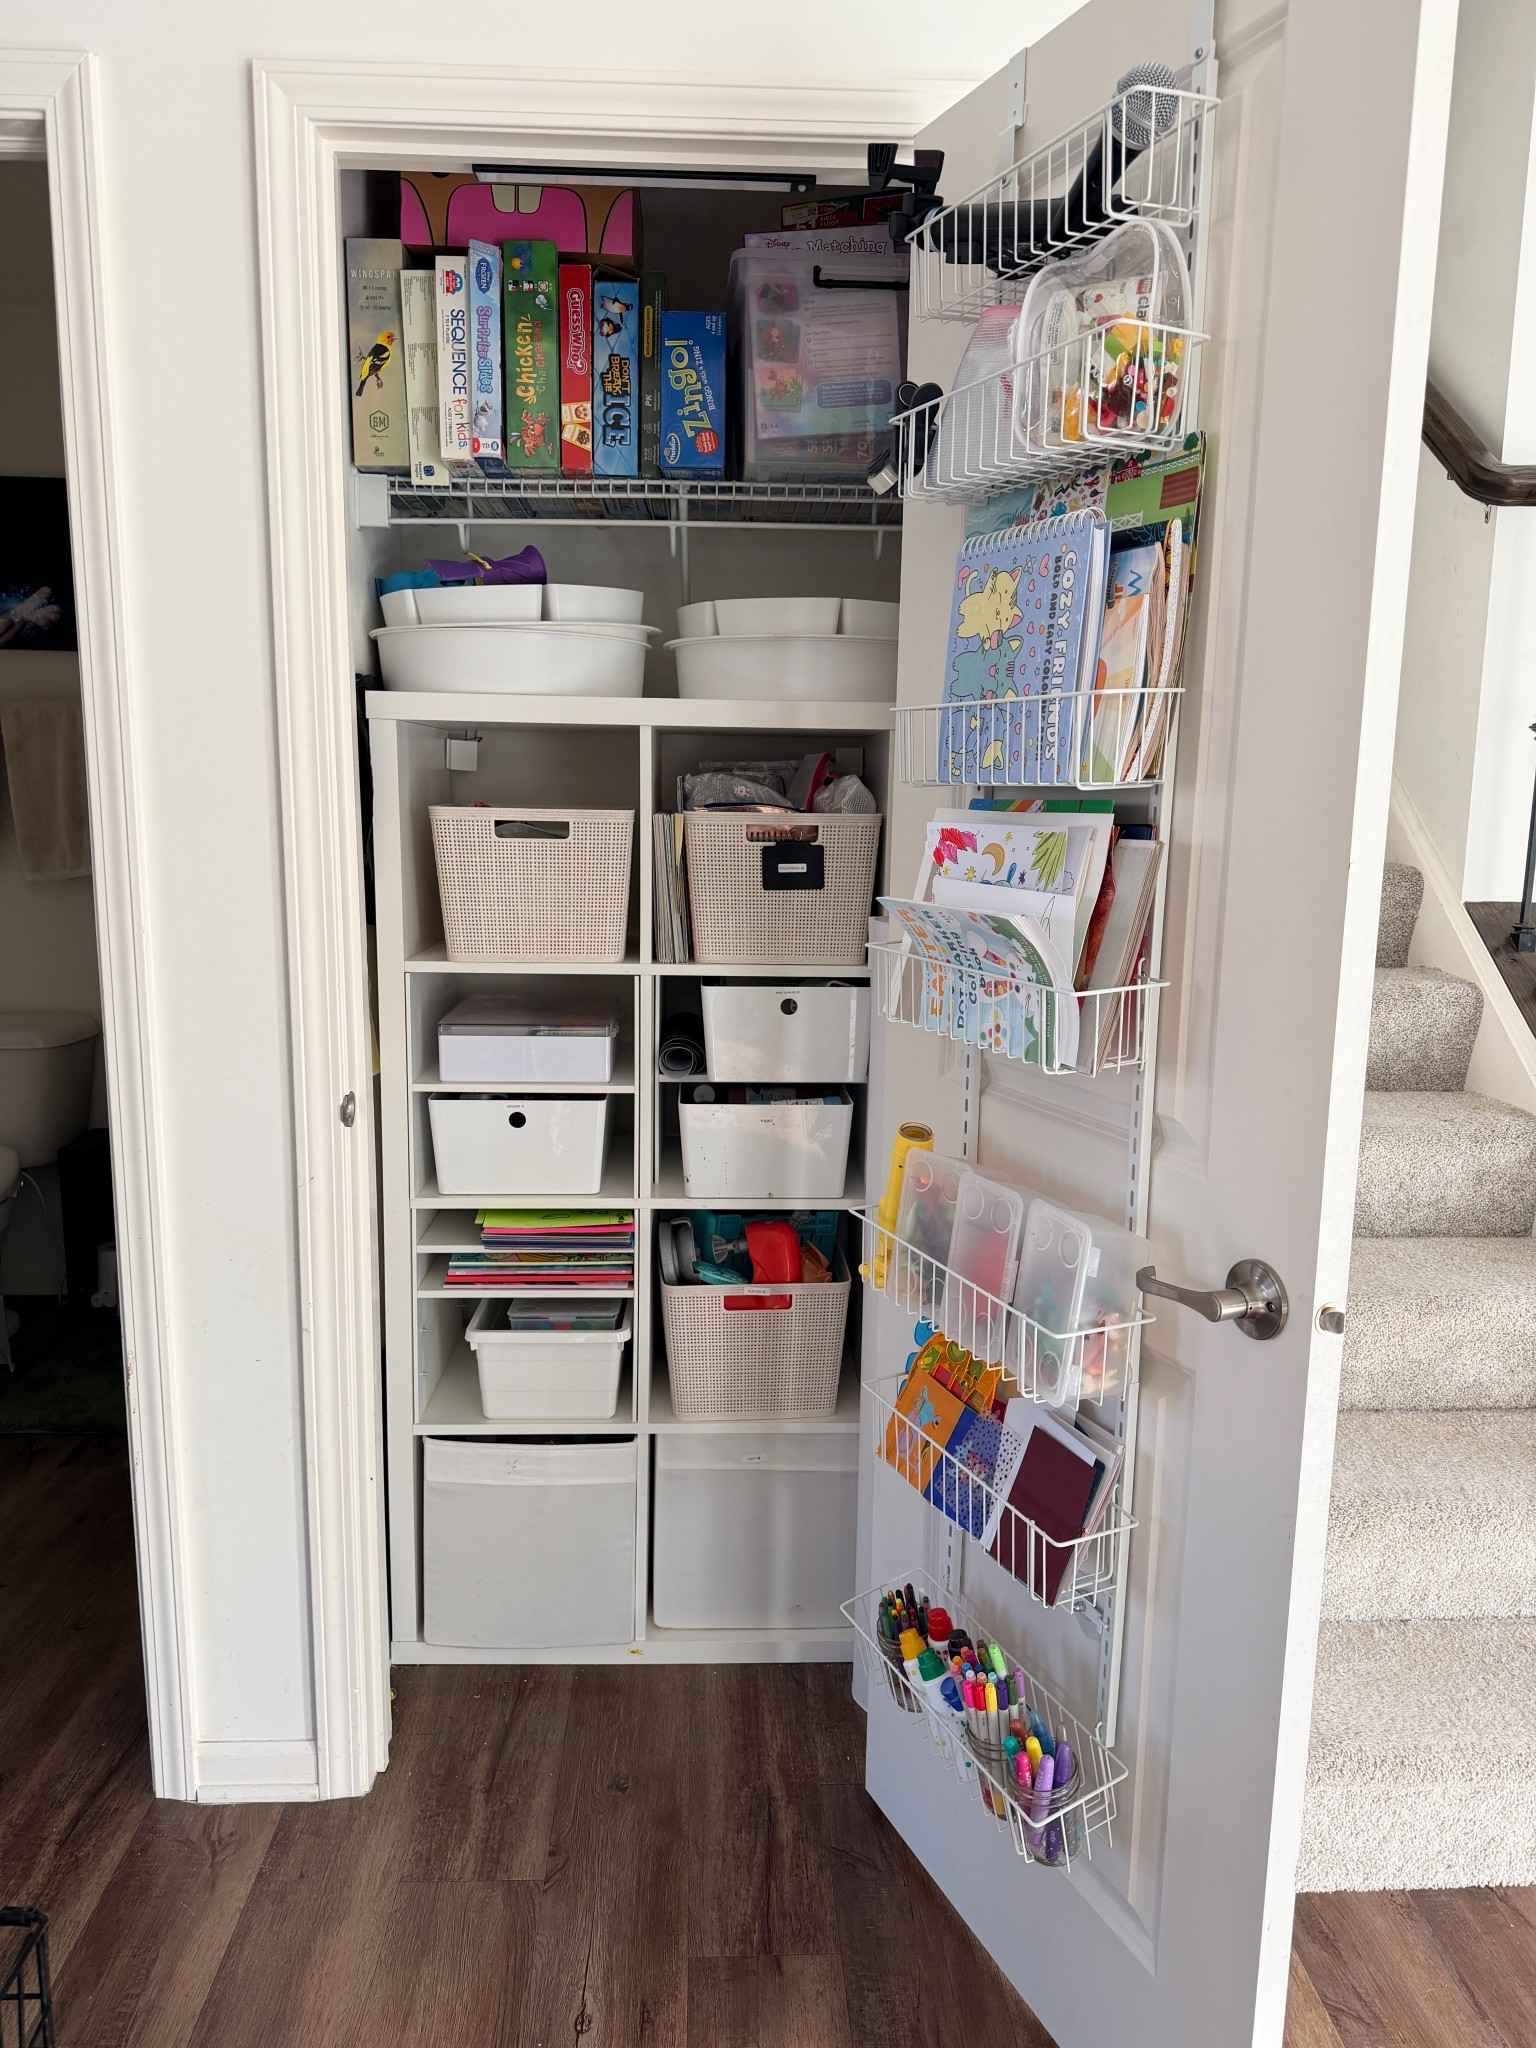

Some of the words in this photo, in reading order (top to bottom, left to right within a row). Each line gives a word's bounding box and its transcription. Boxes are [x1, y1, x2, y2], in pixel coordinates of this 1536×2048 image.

[807, 236, 887, 255] Matching
[350, 269, 399, 279] WINGSPAN
[532, 320, 543, 344] Cha
[450, 308, 467, 395] SEQUENCE
[515, 313, 537, 403] Chicken
[534, 346, 546, 369] Cha
[693, 345, 703, 366] ZING
[478, 357, 493, 394] Slides
[535, 370, 547, 394] Cha
[603, 372, 612, 393] THE
[611, 356, 622, 396] BREAK
[621, 359, 630, 394] DON'T
[664, 338, 712, 438] Zingo!
[700, 369, 708, 385] with
[452, 398, 468, 418] for
[645, 394, 653, 407] PK
[703, 385, 716, 411] BINGO
[603, 394, 631, 448] ICE
[1053, 555, 1062, 589] BOLD
[1057, 550, 1078, 630] COZY
[1049, 592, 1058, 620] AND
[1044, 622, 1054, 656] EASY
[897, 909, 945, 1017] EASTER
[957, 990, 965, 1030] DOT
